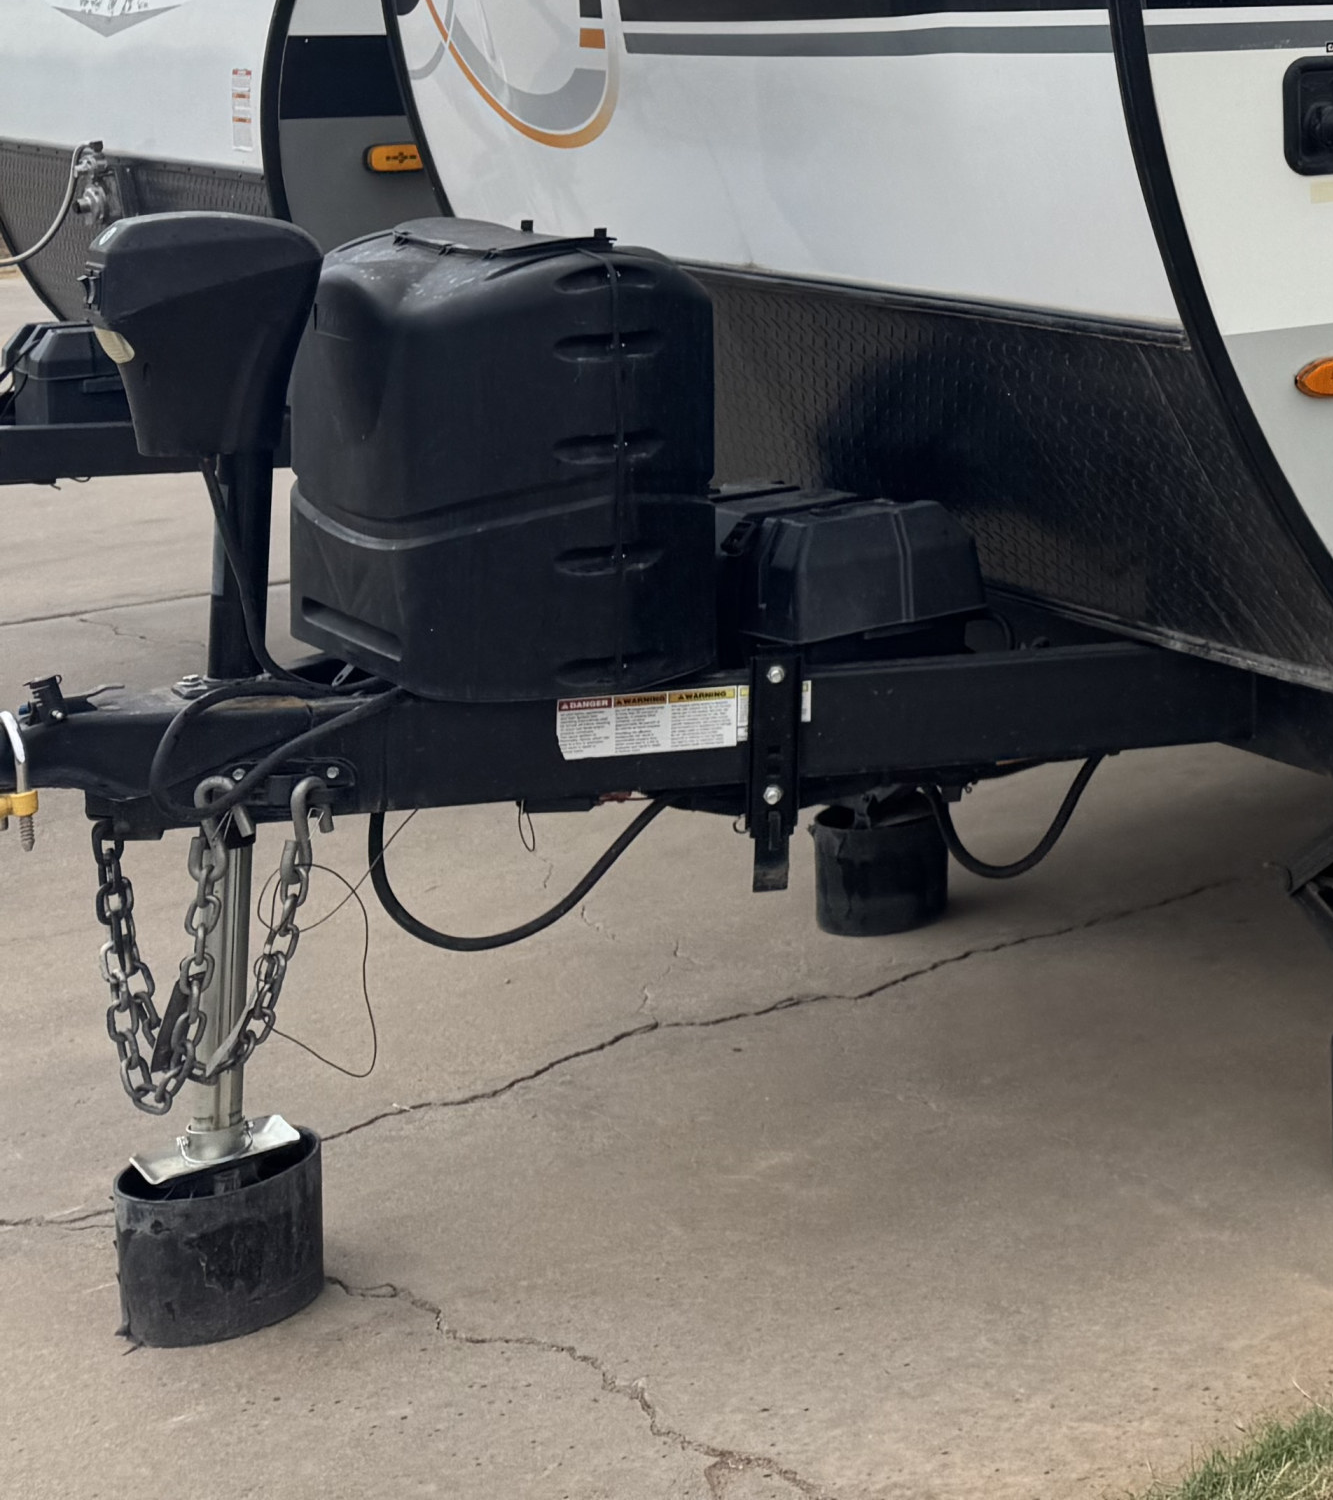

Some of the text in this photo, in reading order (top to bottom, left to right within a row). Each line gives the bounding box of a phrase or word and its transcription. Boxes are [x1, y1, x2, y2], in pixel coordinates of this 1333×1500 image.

[569, 690, 727, 709] DANGER WARNING WARNING
